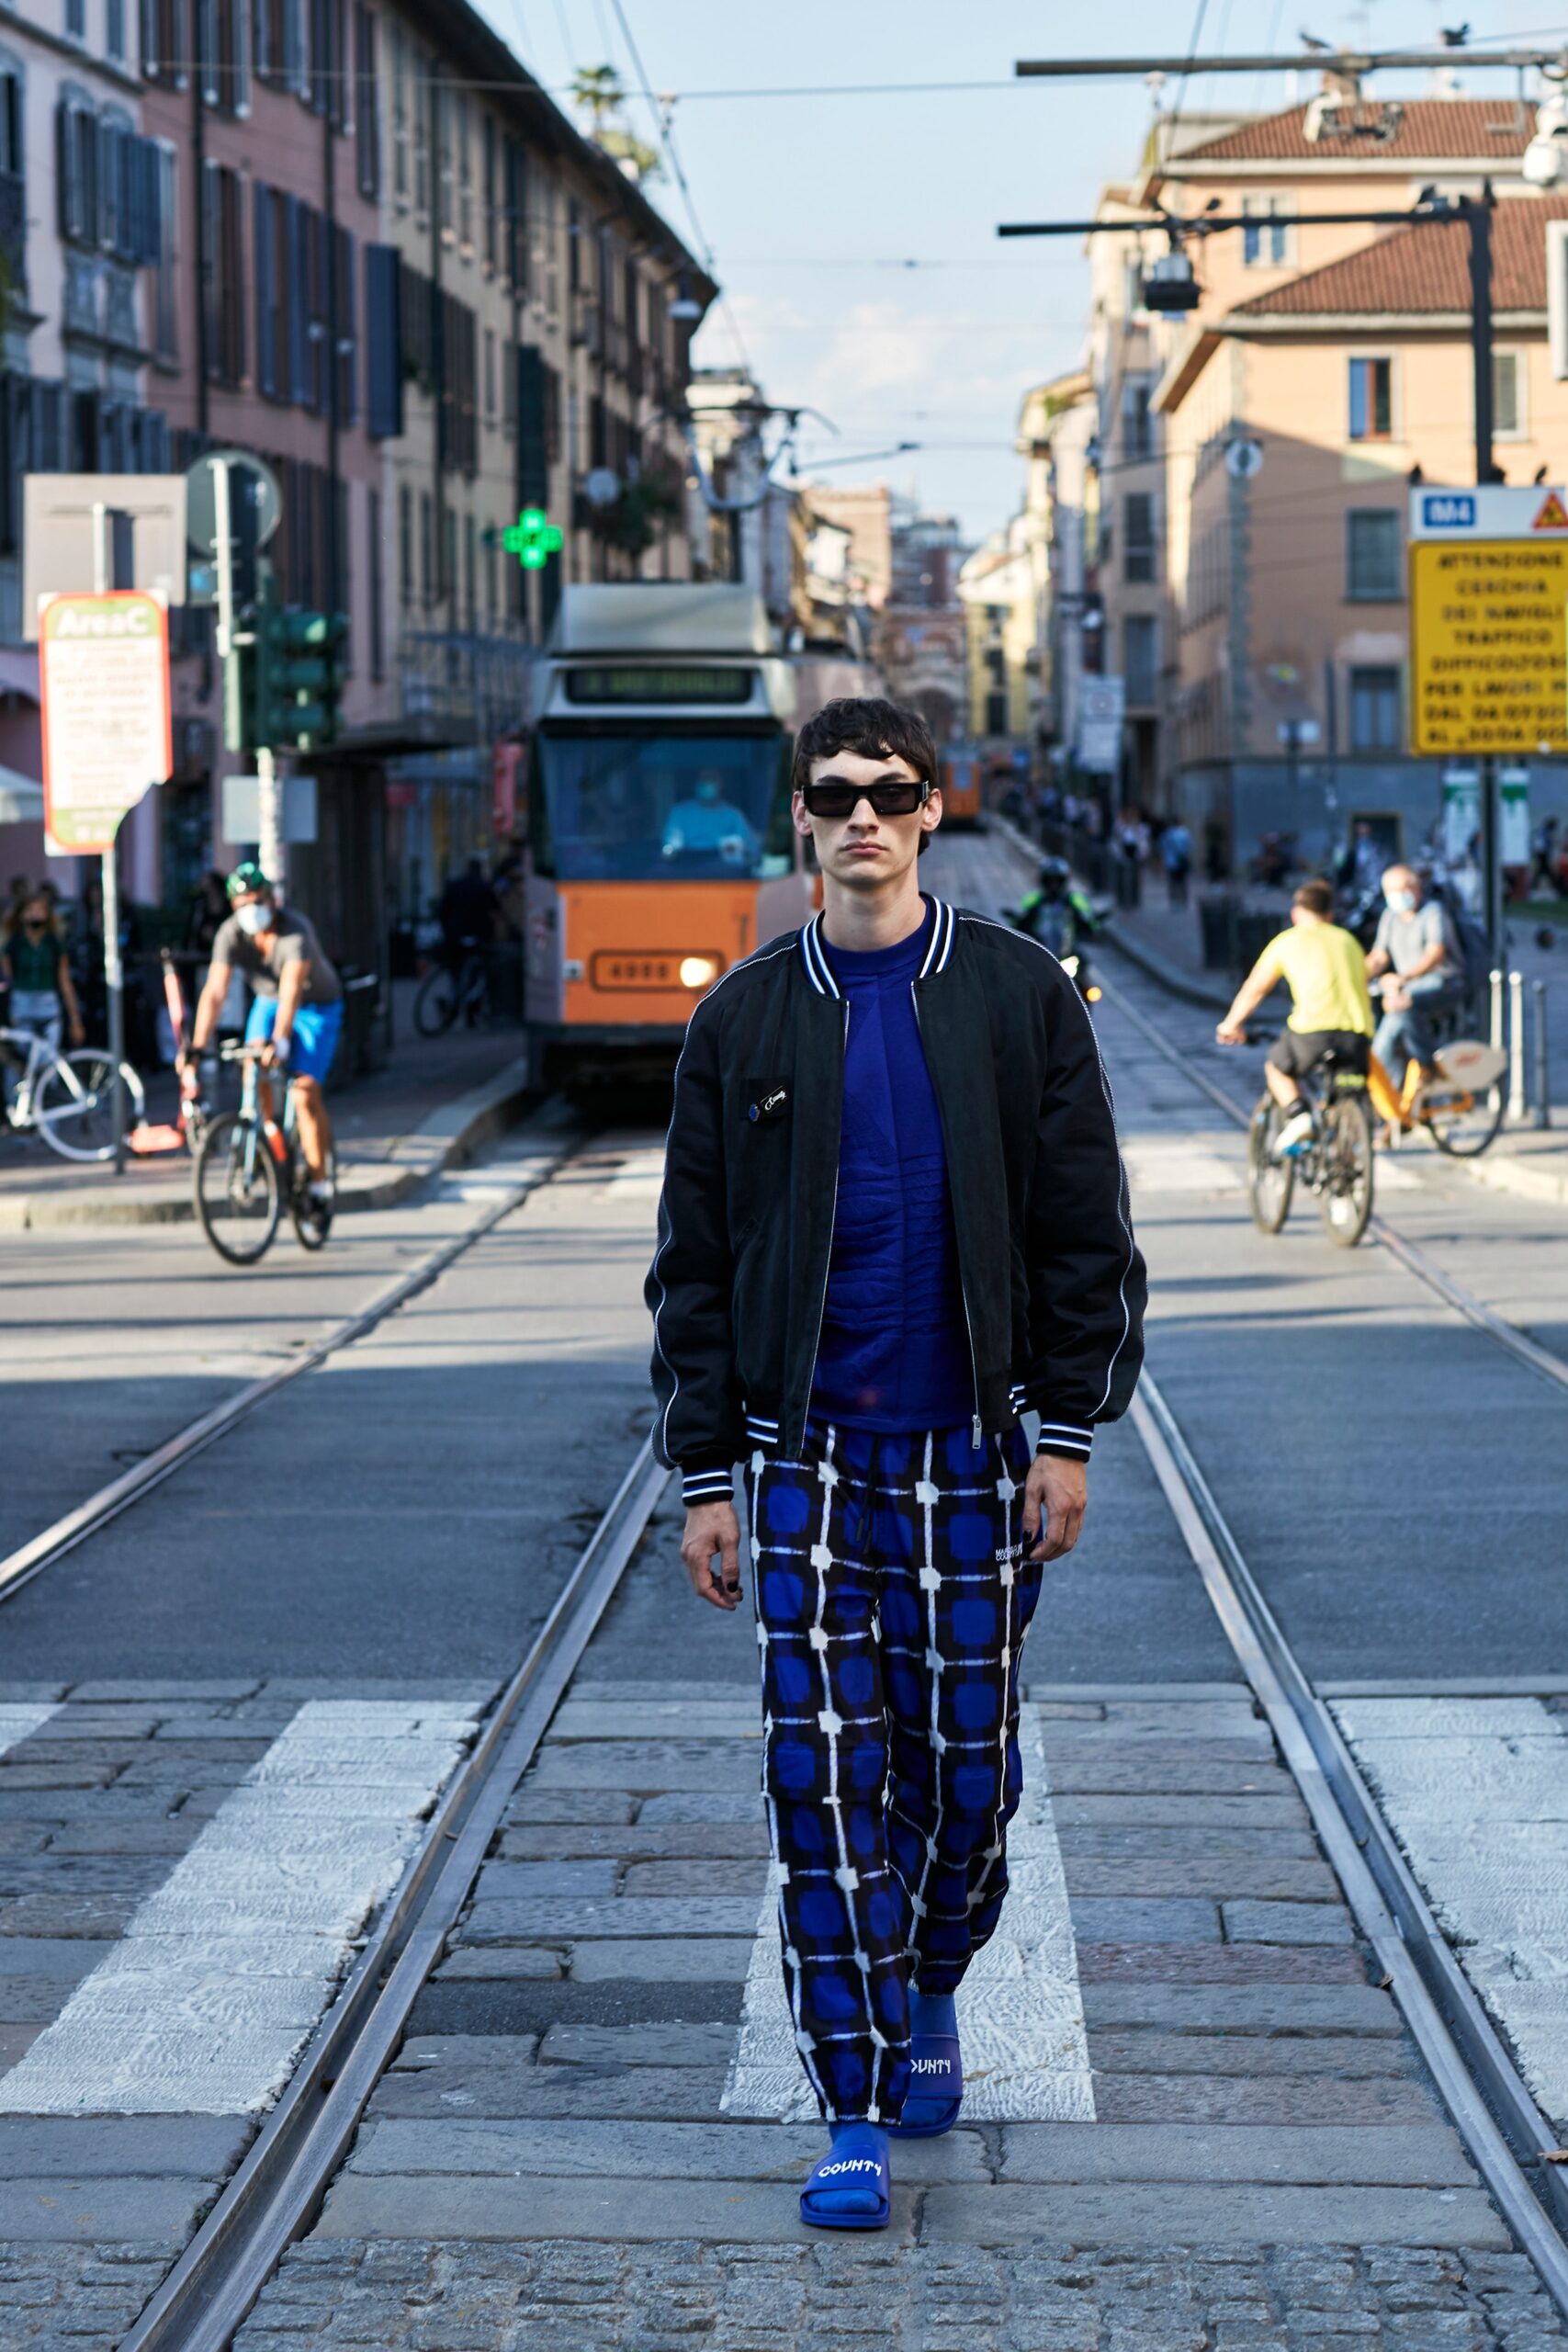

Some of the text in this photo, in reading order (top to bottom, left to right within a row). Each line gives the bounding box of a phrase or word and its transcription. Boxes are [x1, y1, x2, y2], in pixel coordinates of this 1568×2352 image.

[1438, 552, 1563, 570] ATTENZIONE
[1453, 628, 1552, 645] TRAFFICO
[1426, 681, 1463, 696] PER
[1426, 704, 1461, 721] DAL
[818, 2159, 882, 2178] COUNTY
